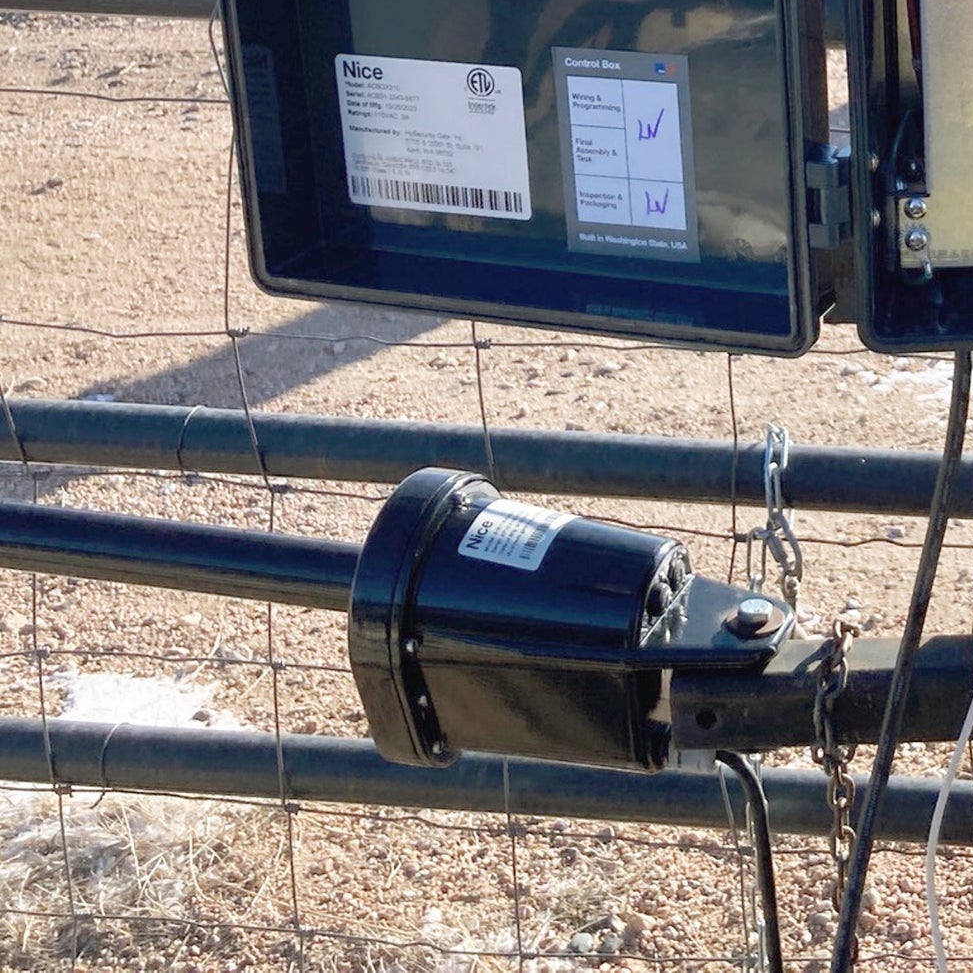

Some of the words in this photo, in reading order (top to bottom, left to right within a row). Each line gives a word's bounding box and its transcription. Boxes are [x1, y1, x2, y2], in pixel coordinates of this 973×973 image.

[564, 57, 600, 69] Control
[602, 59, 621, 70] Box
[342, 60, 384, 80] Nice
[572, 92, 595, 103] Wiring
[596, 94, 602, 102] &
[572, 101, 621, 113] Programming
[575, 137, 593, 146] Final
[575, 146, 610, 157] Assembly
[580, 199, 617, 209] Packaging
[579, 232, 596, 242] Built
[597, 234, 604, 242] in
[605, 235, 647, 247] Washington
[671, 241, 688, 250] USA
[466, 520, 493, 550] Nice
